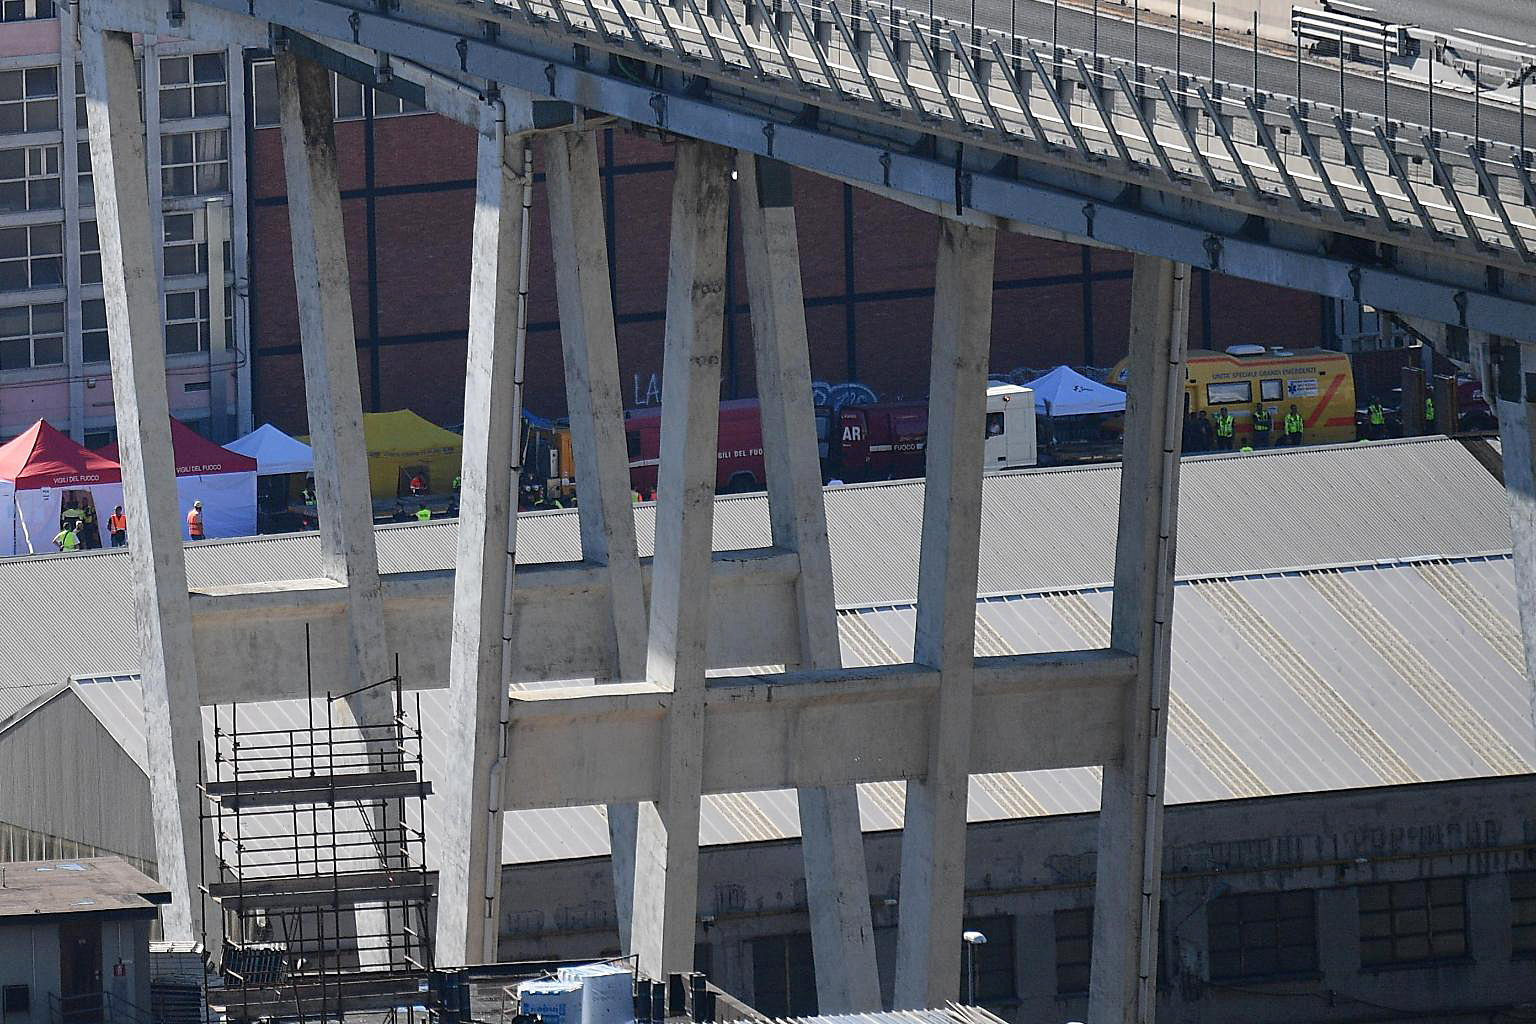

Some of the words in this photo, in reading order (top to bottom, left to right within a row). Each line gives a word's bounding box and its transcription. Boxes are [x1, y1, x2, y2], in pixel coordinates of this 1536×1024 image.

[842, 426, 861, 441] AR
[718, 450, 731, 459] GILI
[734, 449, 746, 458] DEL
[749, 448, 763, 456] FUO
[203, 463, 222, 471] FUOCO
[80, 474, 99, 482] FUOCO
